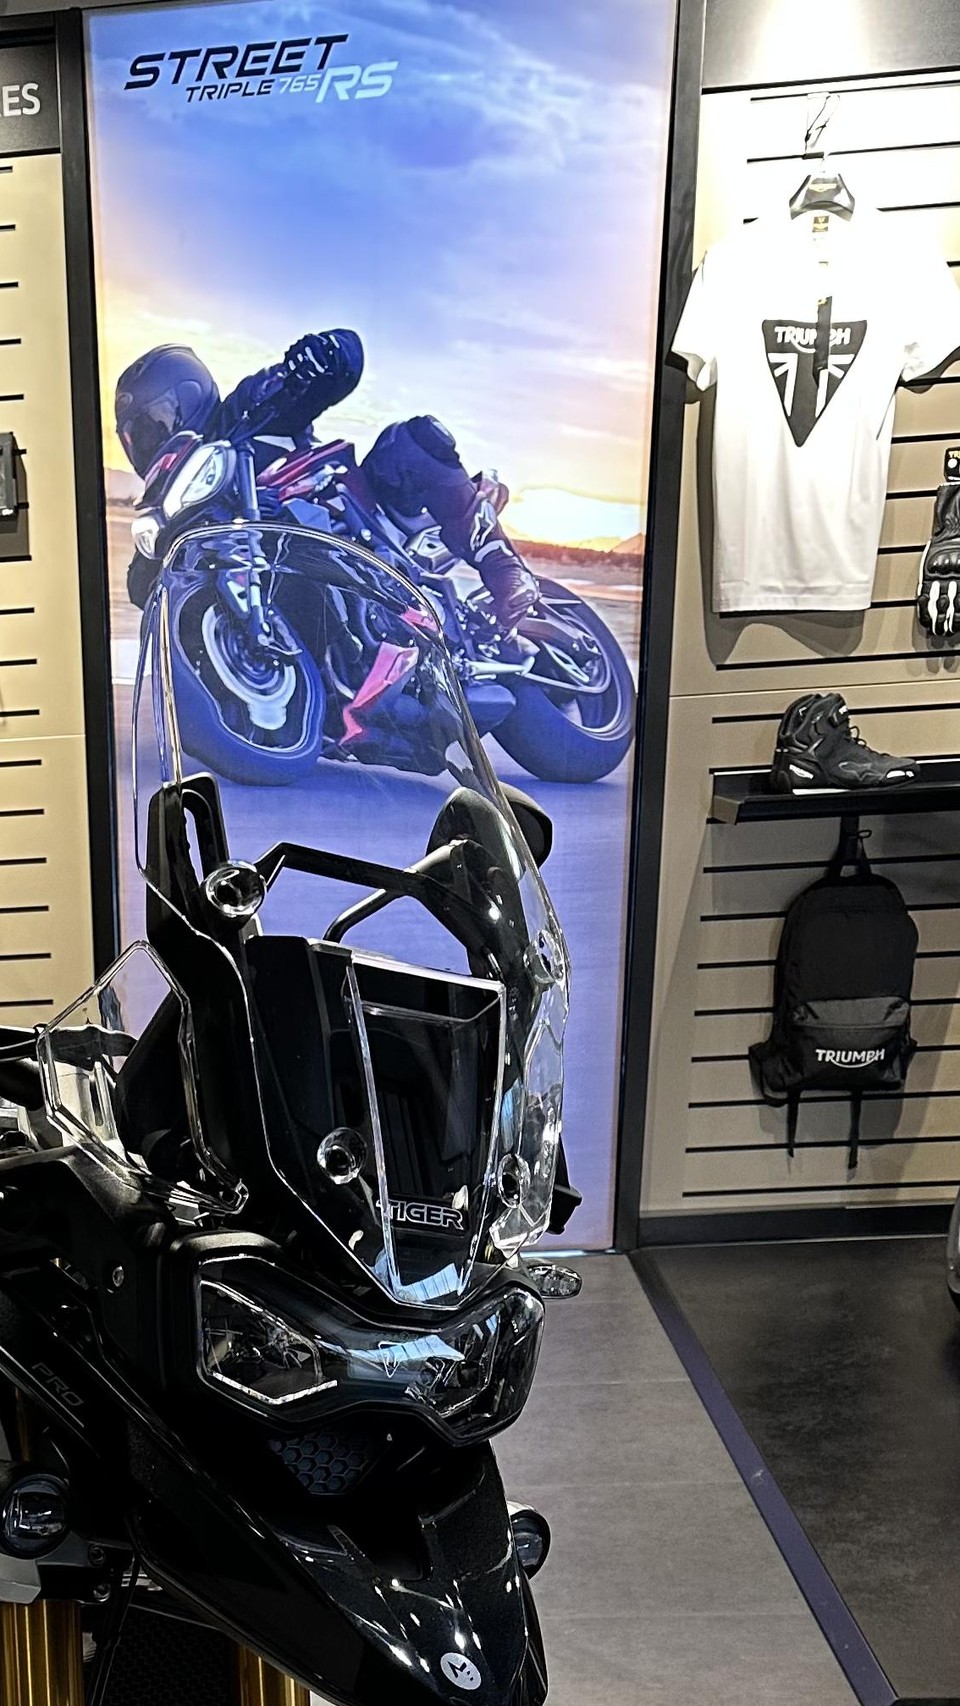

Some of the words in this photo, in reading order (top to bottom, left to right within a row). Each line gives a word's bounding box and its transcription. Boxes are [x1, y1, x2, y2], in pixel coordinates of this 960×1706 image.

[124, 34, 349, 91] STREET
[186, 79, 275, 103] TRIPLE
[279, 74, 323, 94] 765
[315, 61, 399, 104] RS
[815, 1048, 885, 1068] TRIUMPH
[376, 1199, 464, 1230] TIGER
[31, 1361, 85, 1407] PRO
